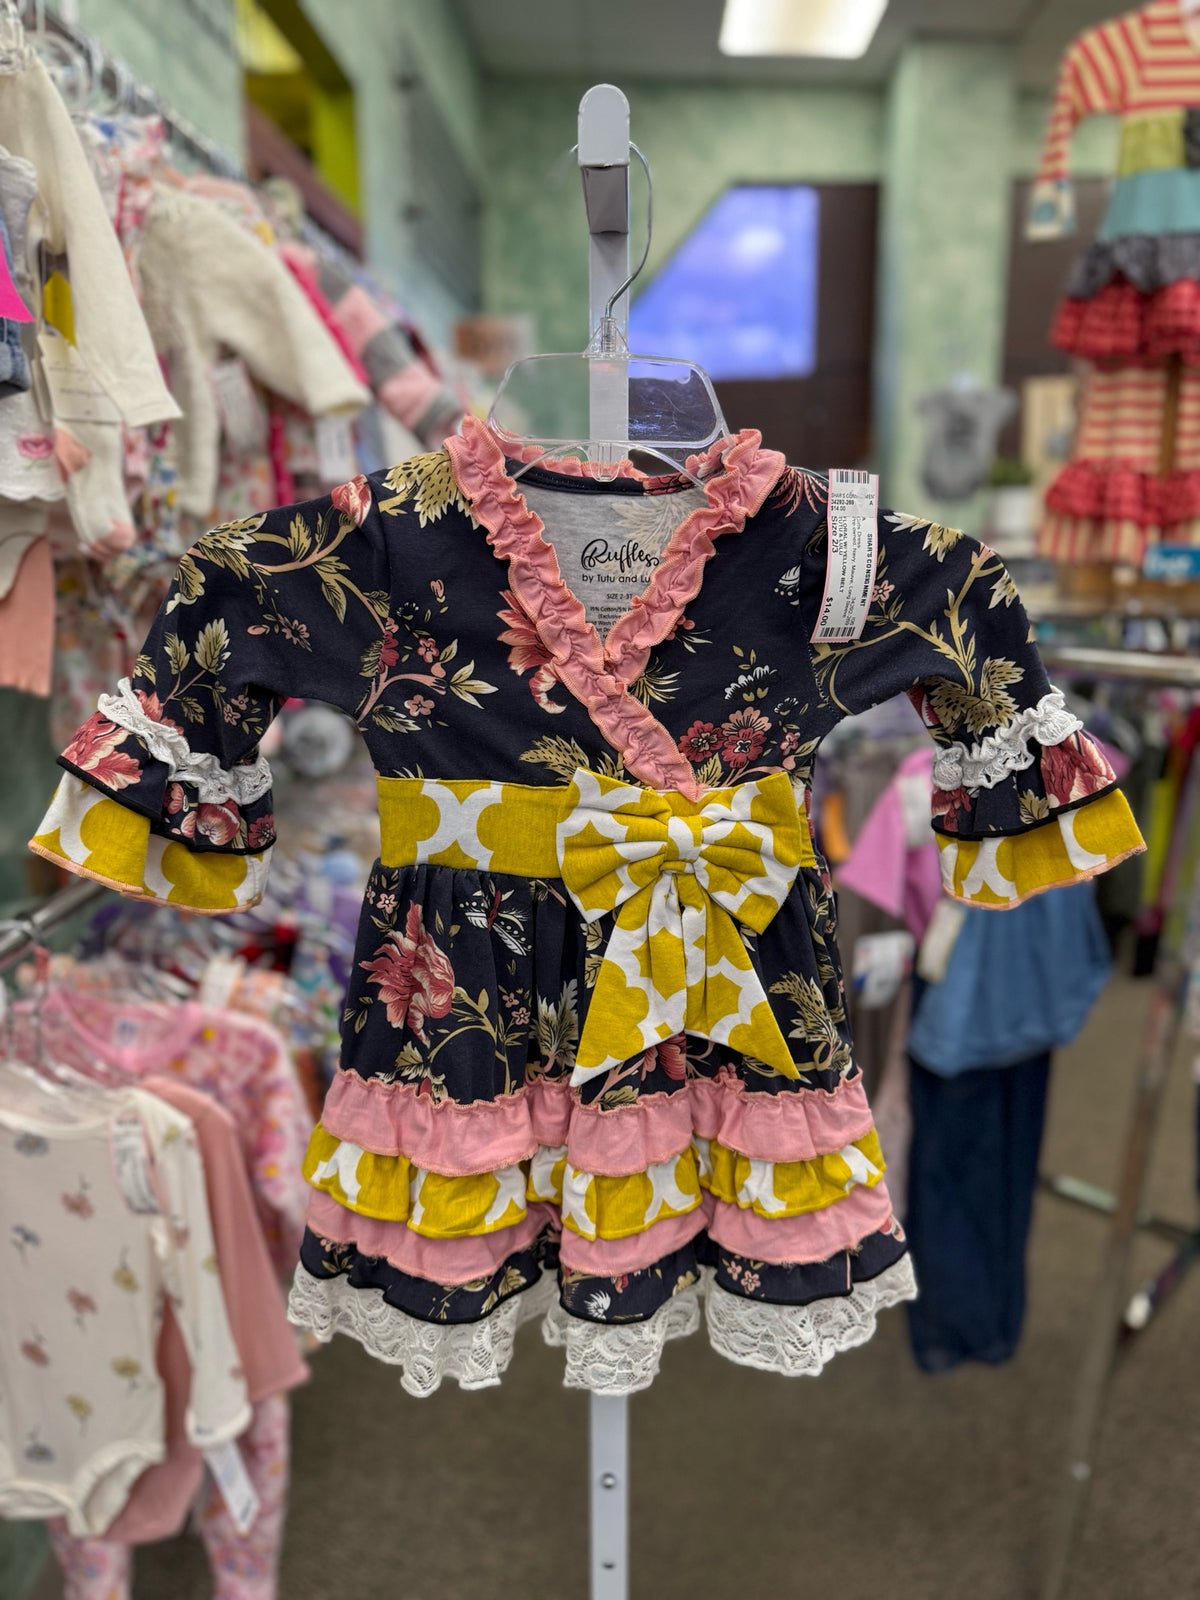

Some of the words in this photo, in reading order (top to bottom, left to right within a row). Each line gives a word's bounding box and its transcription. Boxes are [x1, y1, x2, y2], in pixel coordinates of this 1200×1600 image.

[581, 538, 660, 573] Ruffles
[582, 574, 594, 584] by
[597, 574, 616, 583] Tutu
[618, 574, 637, 583] and
[640, 574, 651, 583] Lu
[820, 597, 833, 626] $14.00
